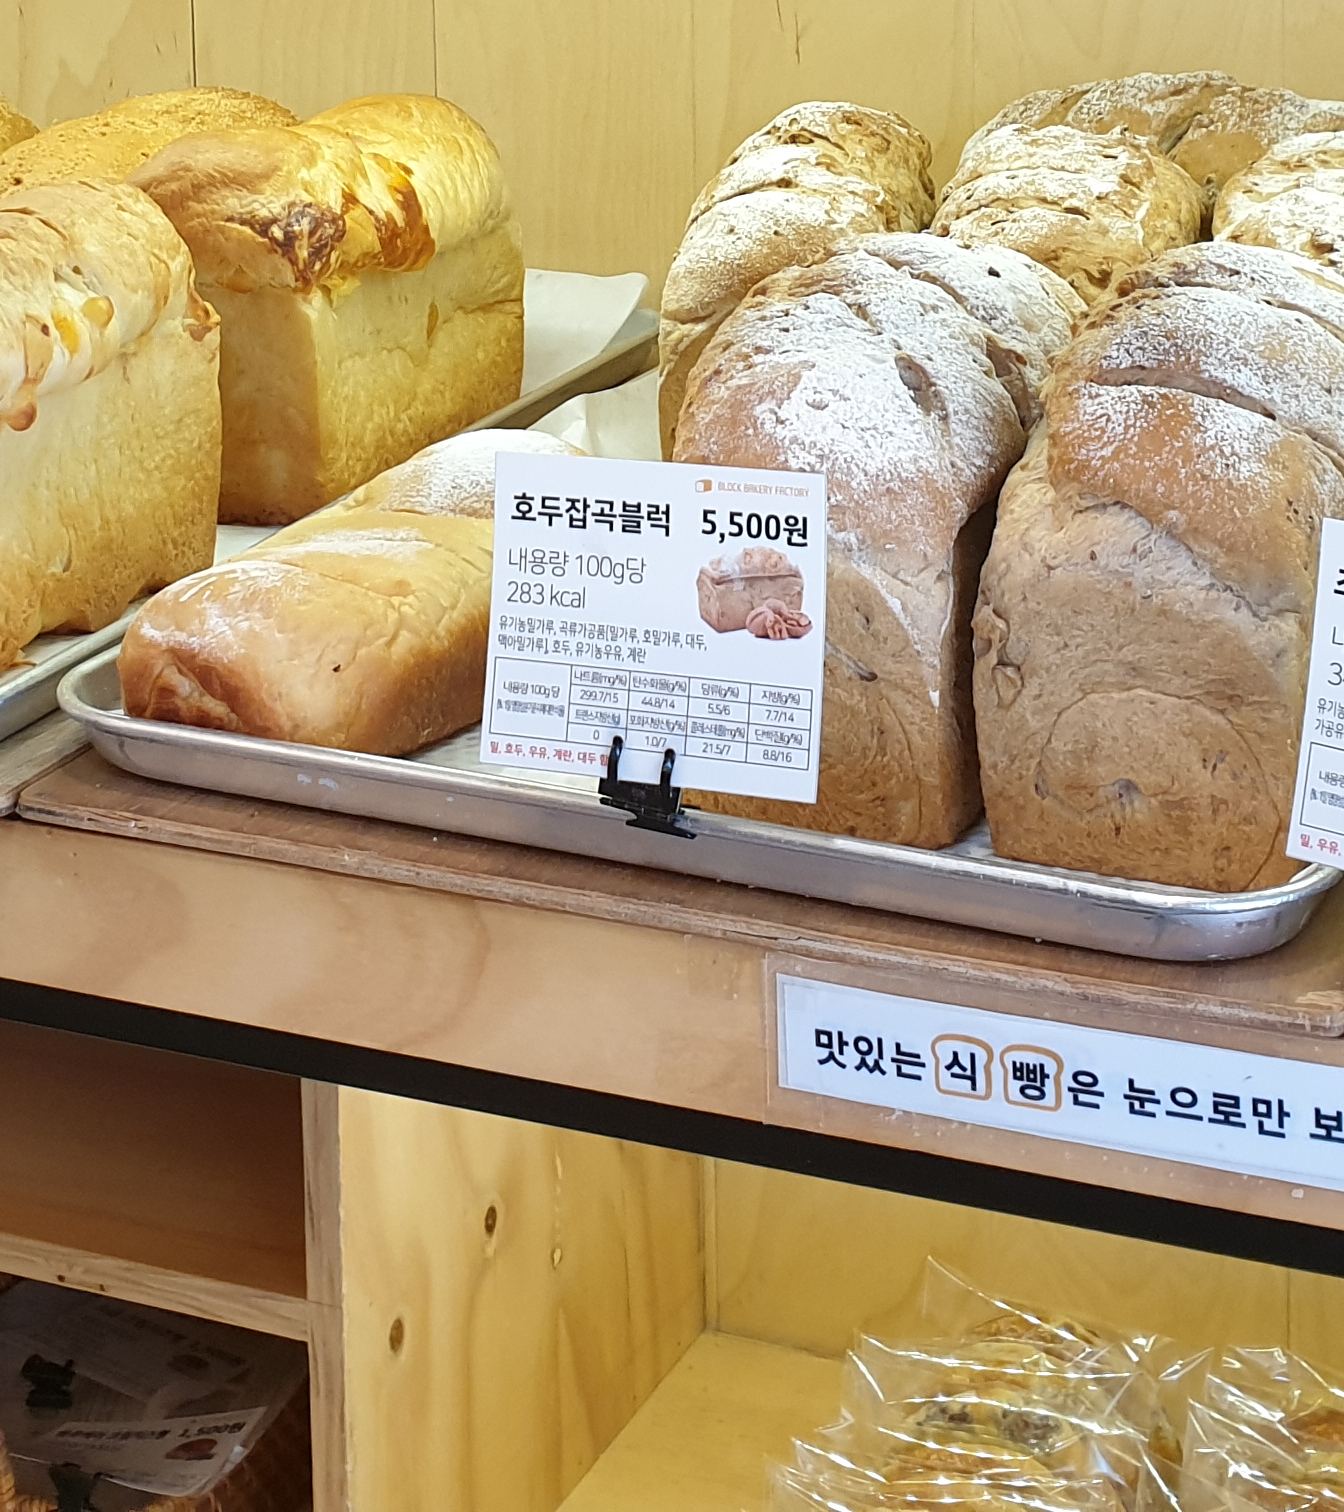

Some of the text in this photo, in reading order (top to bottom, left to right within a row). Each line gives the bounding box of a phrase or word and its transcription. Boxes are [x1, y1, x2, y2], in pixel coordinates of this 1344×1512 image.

[511, 492, 671, 537] 호두잡곡블럭
[701, 509, 809, 547] 5,500원
[509, 547, 647, 585] 내용량 100g당
[507, 581, 586, 609] 283 kcal
[627, 647, 647, 663] 계란
[814, 1028, 926, 1080] 맛있는
[1124, 1078, 1291, 1138] 눈으로만
